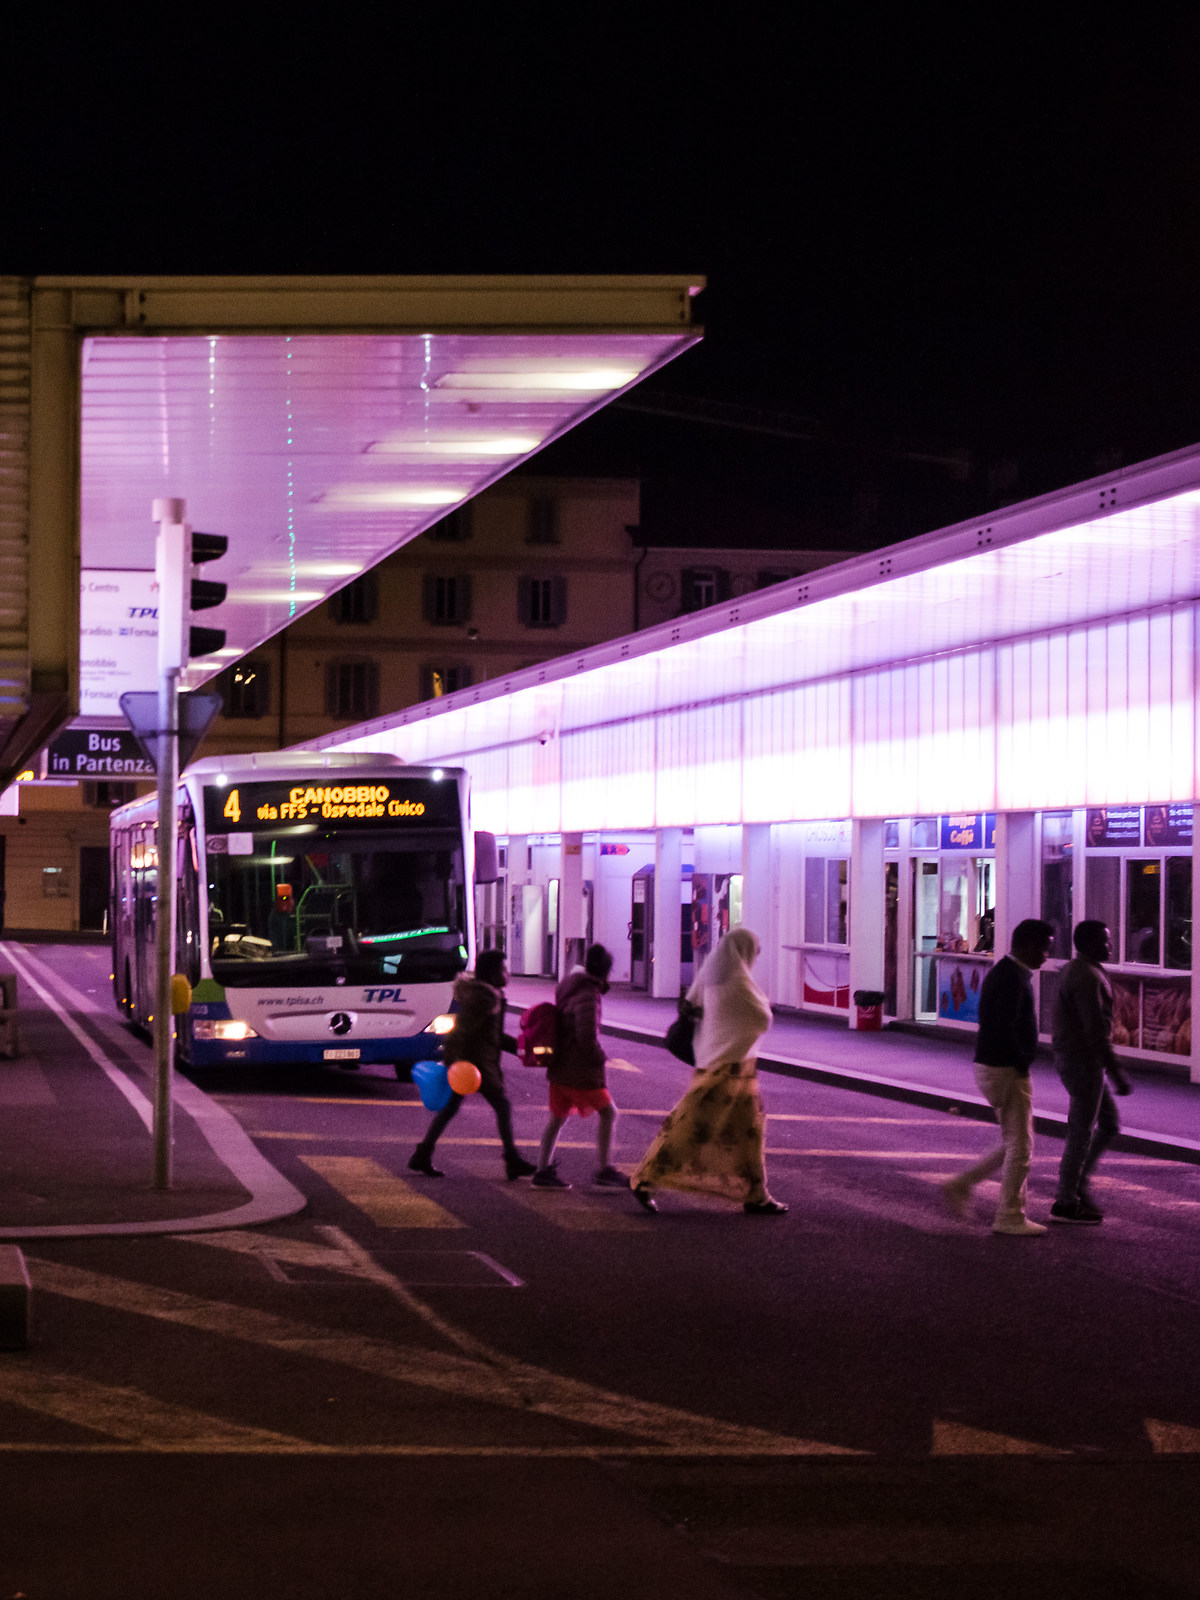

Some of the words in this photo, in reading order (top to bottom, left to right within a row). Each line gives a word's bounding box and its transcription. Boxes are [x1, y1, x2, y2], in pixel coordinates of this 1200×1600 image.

[128, 607, 158, 619] TPL
[88, 733, 121, 752] Bus
[52, 753, 70, 771] in
[224, 789, 241, 823] 4
[289, 786, 390, 804] CANOBBIO
[256, 803, 278, 820] via
[280, 802, 308, 820] FFS
[321, 802, 386, 819] Ospedale
[387, 800, 425, 817] Civico
[364, 989, 406, 1003] TPL
